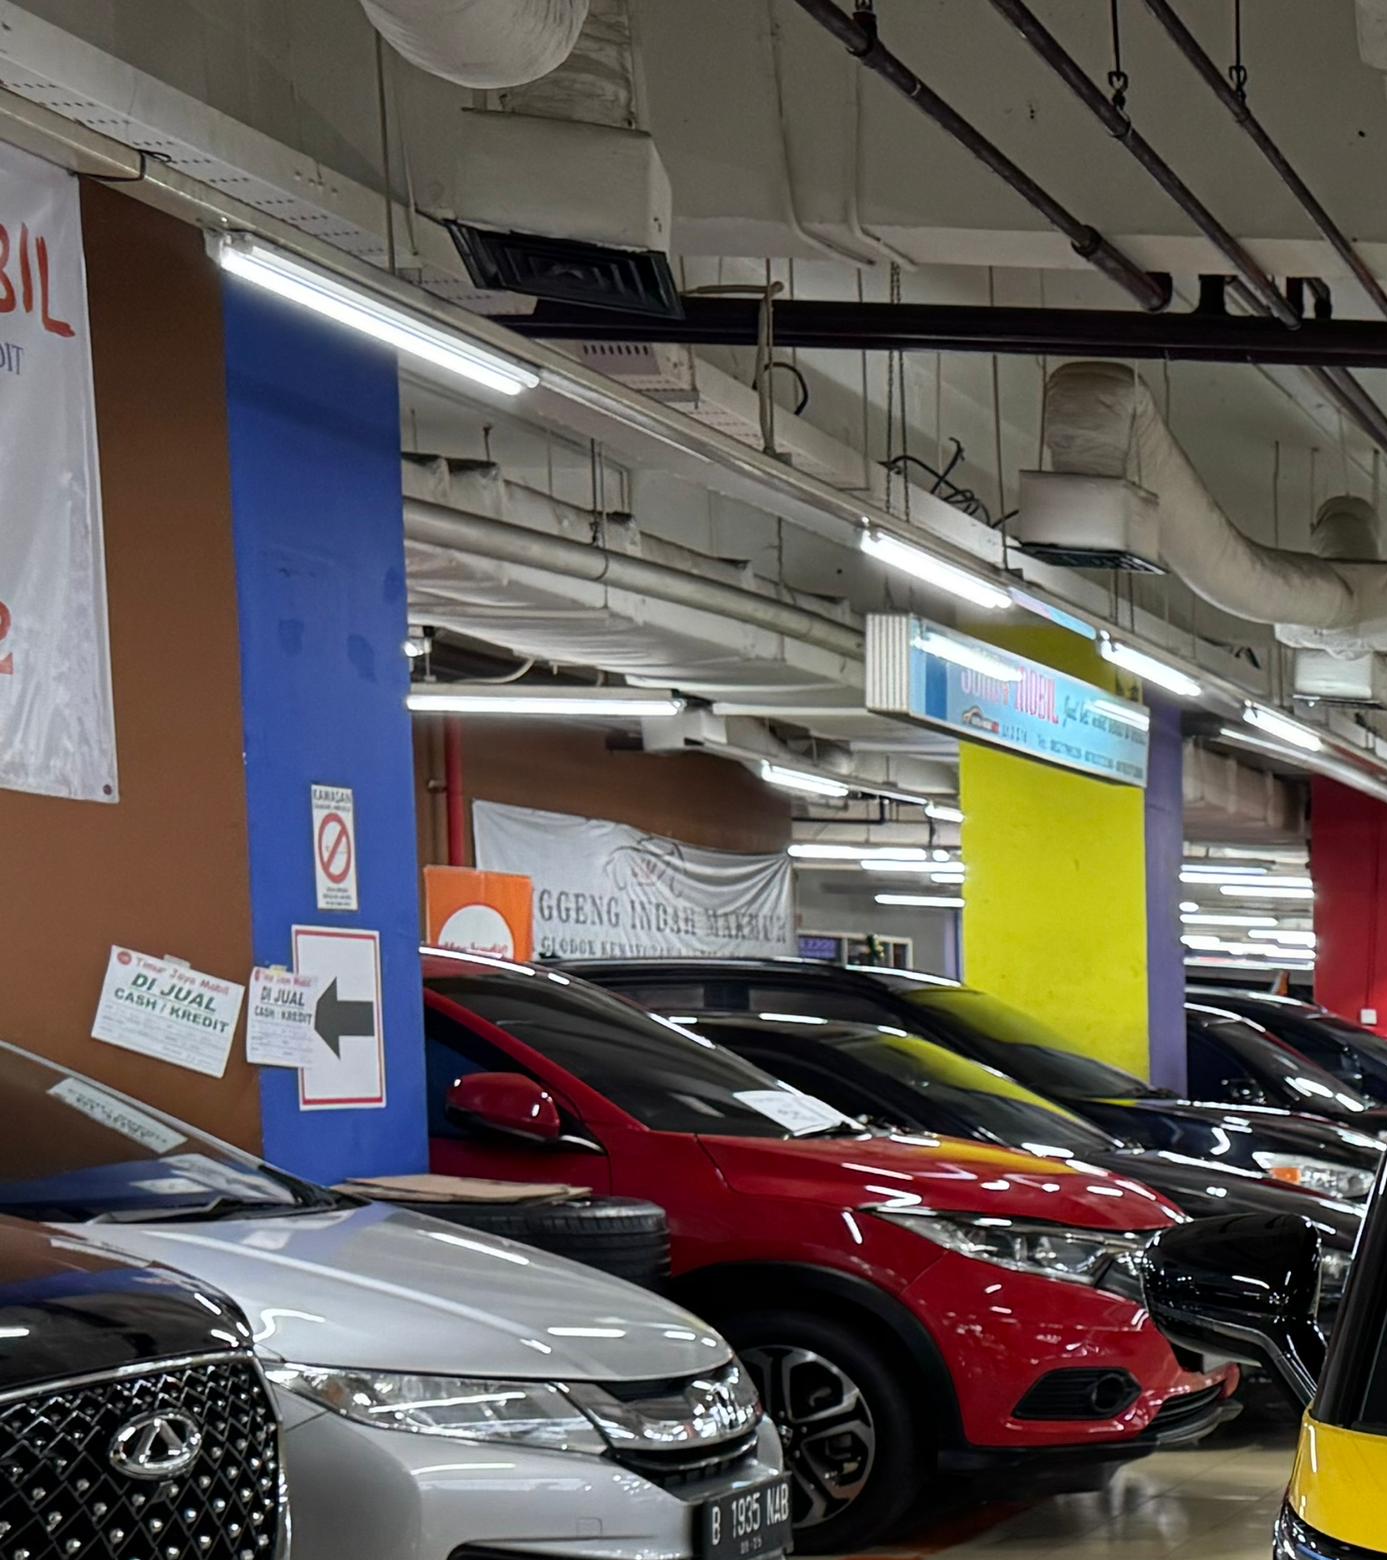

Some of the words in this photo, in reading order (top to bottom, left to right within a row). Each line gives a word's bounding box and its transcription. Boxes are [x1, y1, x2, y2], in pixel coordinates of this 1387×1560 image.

[114, 988, 158, 1011] CASH
[170, 1005, 230, 1034] KREDIT
[131, 973, 157, 991] DI
[160, 984, 217, 1013] JUAL
[274, 988, 305, 1007] JUAL
[712, 1506, 721, 1546] B
[732, 1492, 761, 1539] 1935
[767, 1483, 790, 1526] NAB
